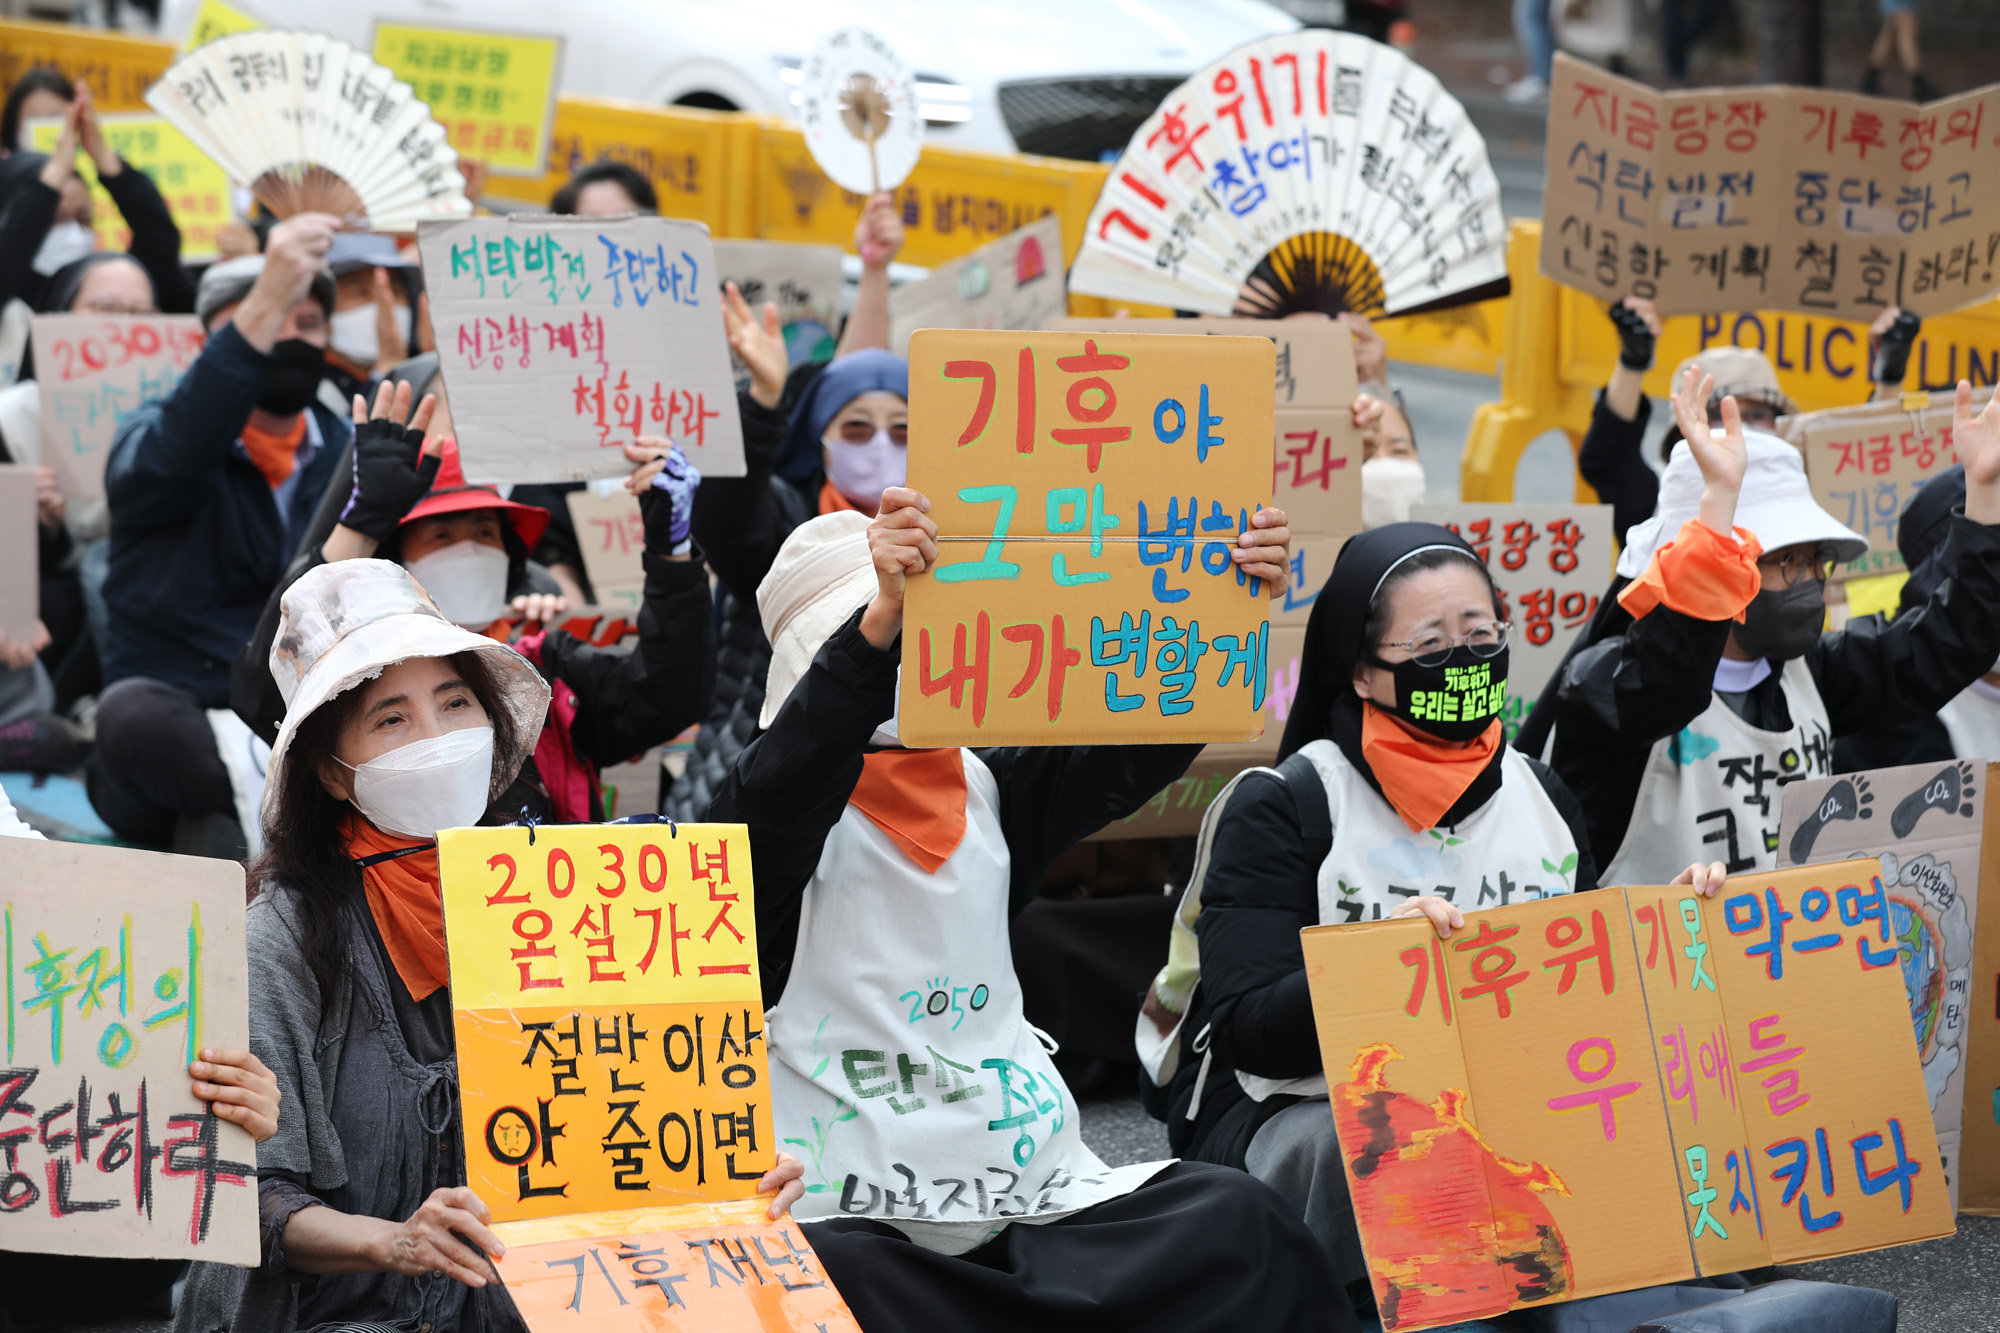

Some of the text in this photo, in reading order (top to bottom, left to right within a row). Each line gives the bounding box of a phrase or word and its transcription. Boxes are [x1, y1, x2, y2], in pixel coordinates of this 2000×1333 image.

[1573, 80, 1767, 154] 지금당장
[1568, 140, 1973, 234] 석탄발전 중단하고
[451, 232, 592, 305] 석탄발전
[597, 235, 699, 308] 중단하고
[1560, 214, 1670, 301] 신공항
[1688, 243, 1771, 294] 계획
[572, 370, 720, 448] 철회하라
[1273, 428, 1349, 496] 라
[933, 482, 1122, 587] 그만
[1442, 516, 1584, 574] 금당장
[1828, 479, 1928, 542] 기후
[1490, 586, 1599, 647] 정의
[918, 610, 1083, 729] 내가
[1090, 609, 1270, 717] 변할게
[1409, 690, 1459, 722] 우리는
[1445, 669, 1491, 692] 기후위기
[485, 838, 741, 907] 2030년
[510, 901, 752, 993] 온실가스
[899, 976, 990, 1032] 2050
[0, 1066, 258, 1247] 중단하라
[484, 1096, 769, 1203] 안 줄이면
